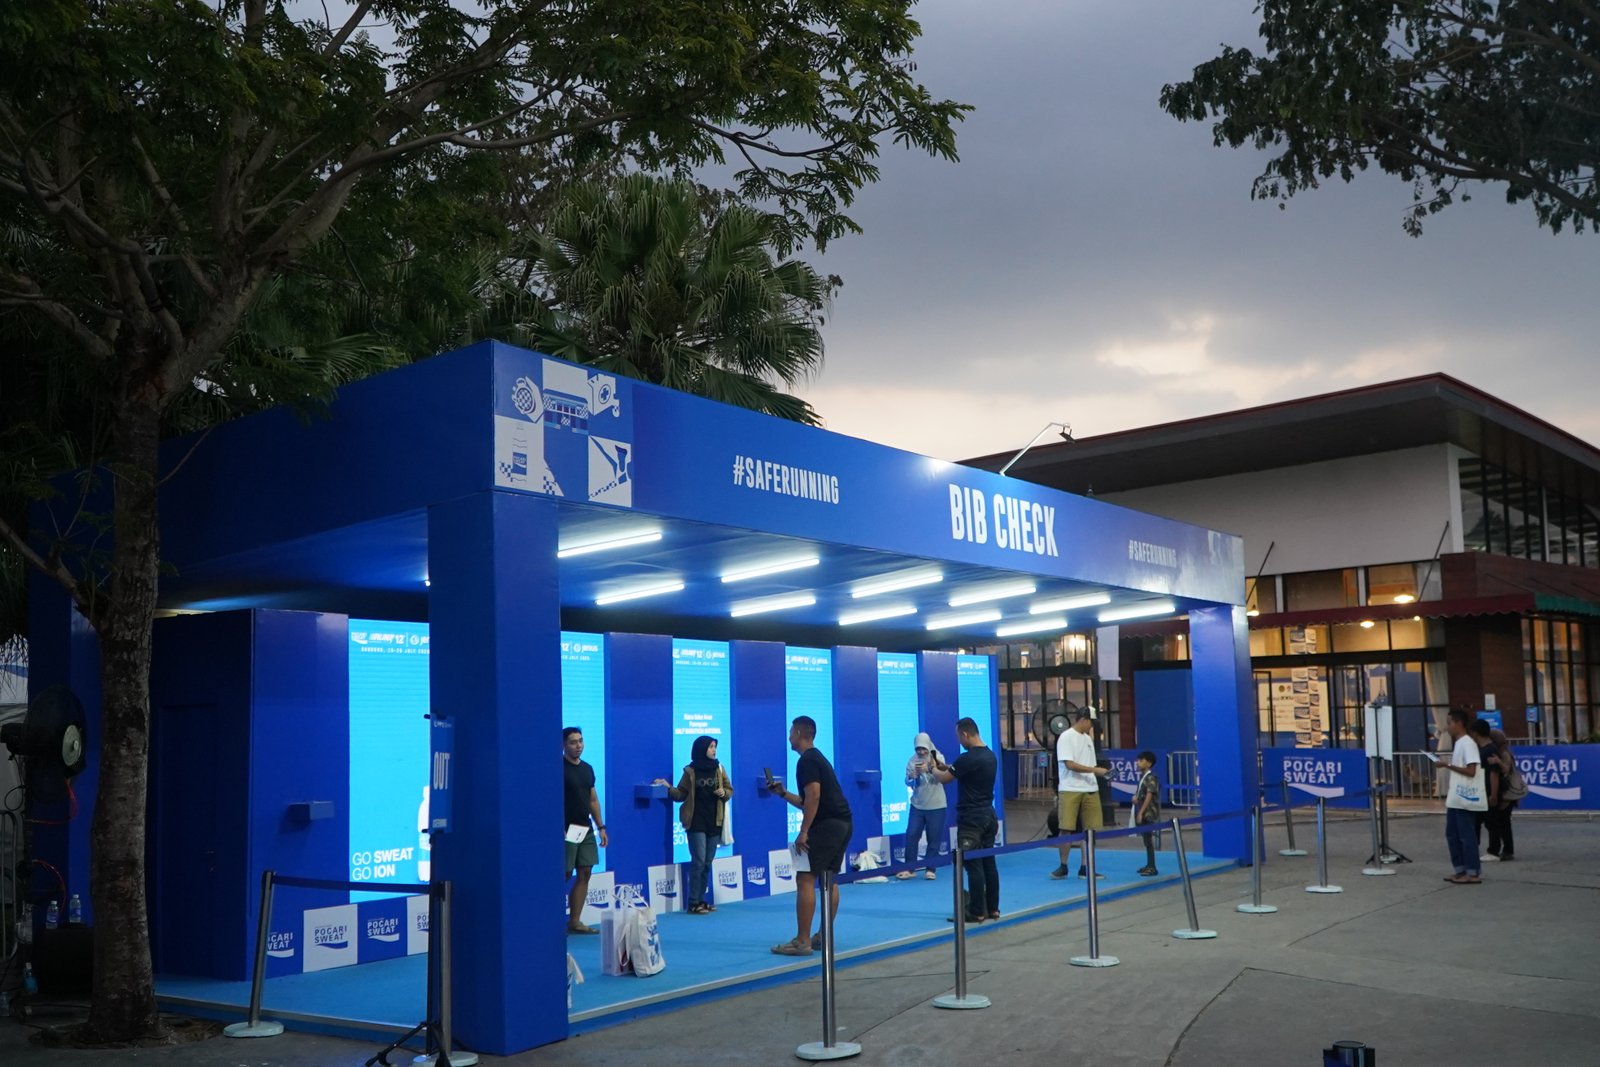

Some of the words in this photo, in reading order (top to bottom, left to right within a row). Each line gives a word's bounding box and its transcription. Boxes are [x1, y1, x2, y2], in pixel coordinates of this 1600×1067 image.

[733, 454, 840, 505] #SAFERUNNING
[949, 483, 988, 545] BIB
[993, 493, 1059, 558] CHECK
[433, 751, 451, 790] OUT
[1283, 760, 1342, 773] POCARI
[1284, 771, 1336, 784] SWEAT
[1521, 772, 1571, 784] WEAT
[352, 851, 372, 866] GO
[373, 847, 414, 863] SWEAT
[352, 866, 372, 880] GO
[373, 864, 396, 879] ION
[588, 889, 608, 898] OCARI
[367, 918, 399, 929] POCARI
[314, 925, 348, 936] POCARI
[367, 926, 395, 937] SWEAT
[314, 934, 344, 944] SWEAT
